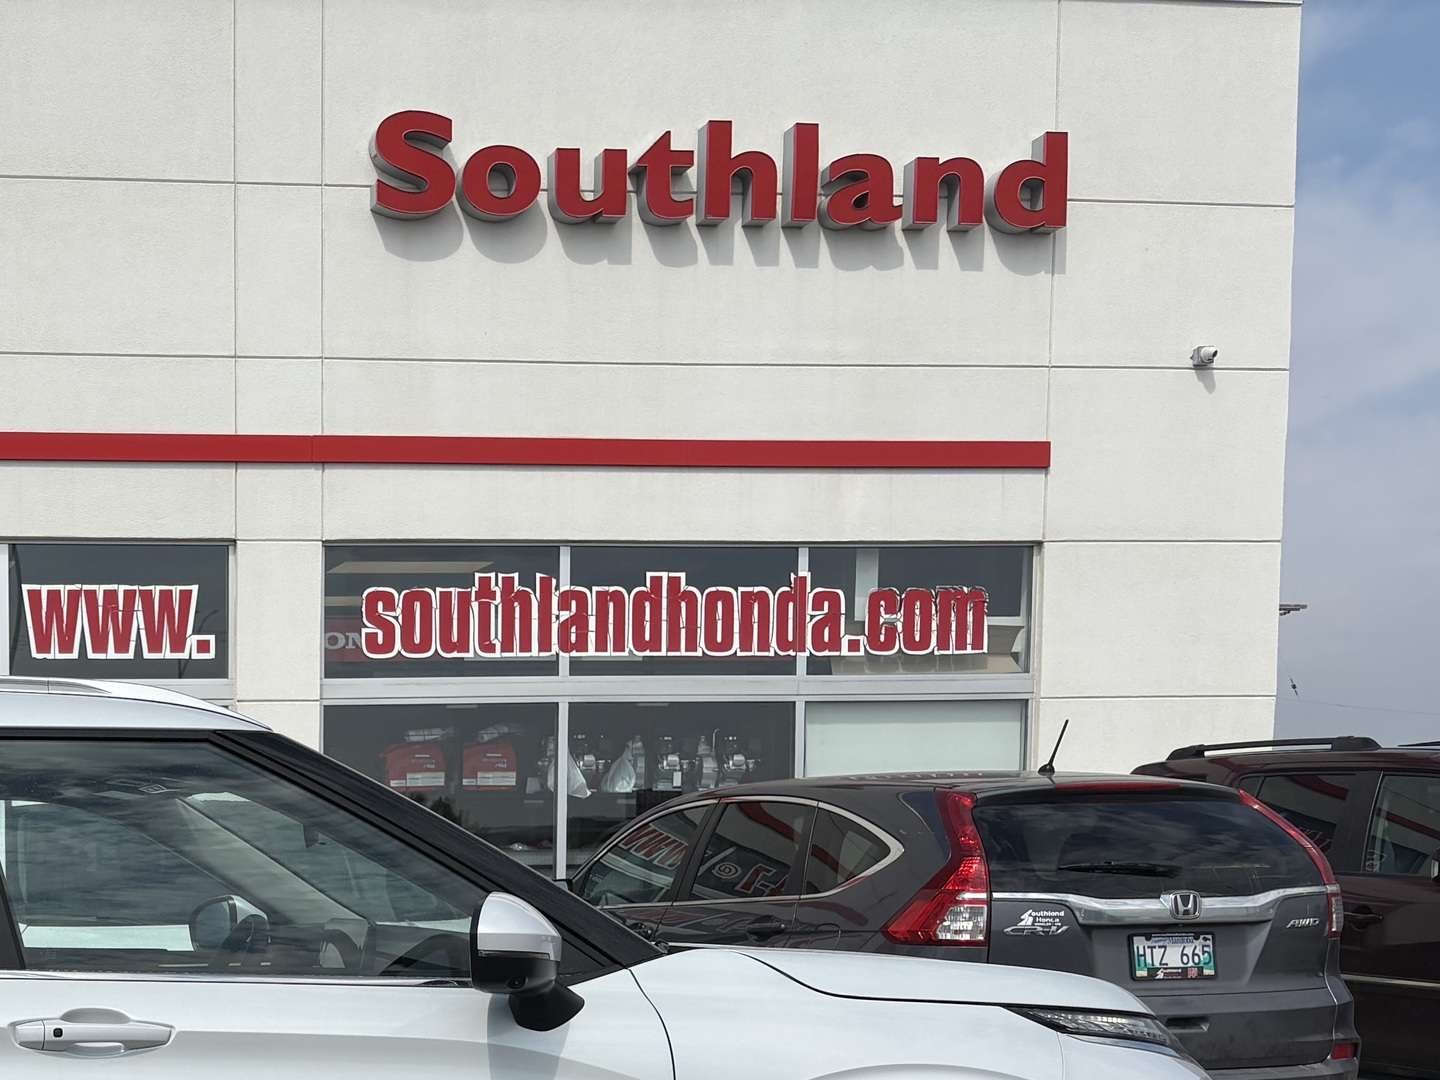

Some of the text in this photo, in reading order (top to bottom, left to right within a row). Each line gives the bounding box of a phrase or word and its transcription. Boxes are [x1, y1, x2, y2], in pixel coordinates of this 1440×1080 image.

[369, 110, 1068, 234] Southland
[361, 572, 990, 659] southlandhonda.com
[1003, 925, 1070, 936] CR-V
[1136, 944, 1213, 968] HTZ 665
